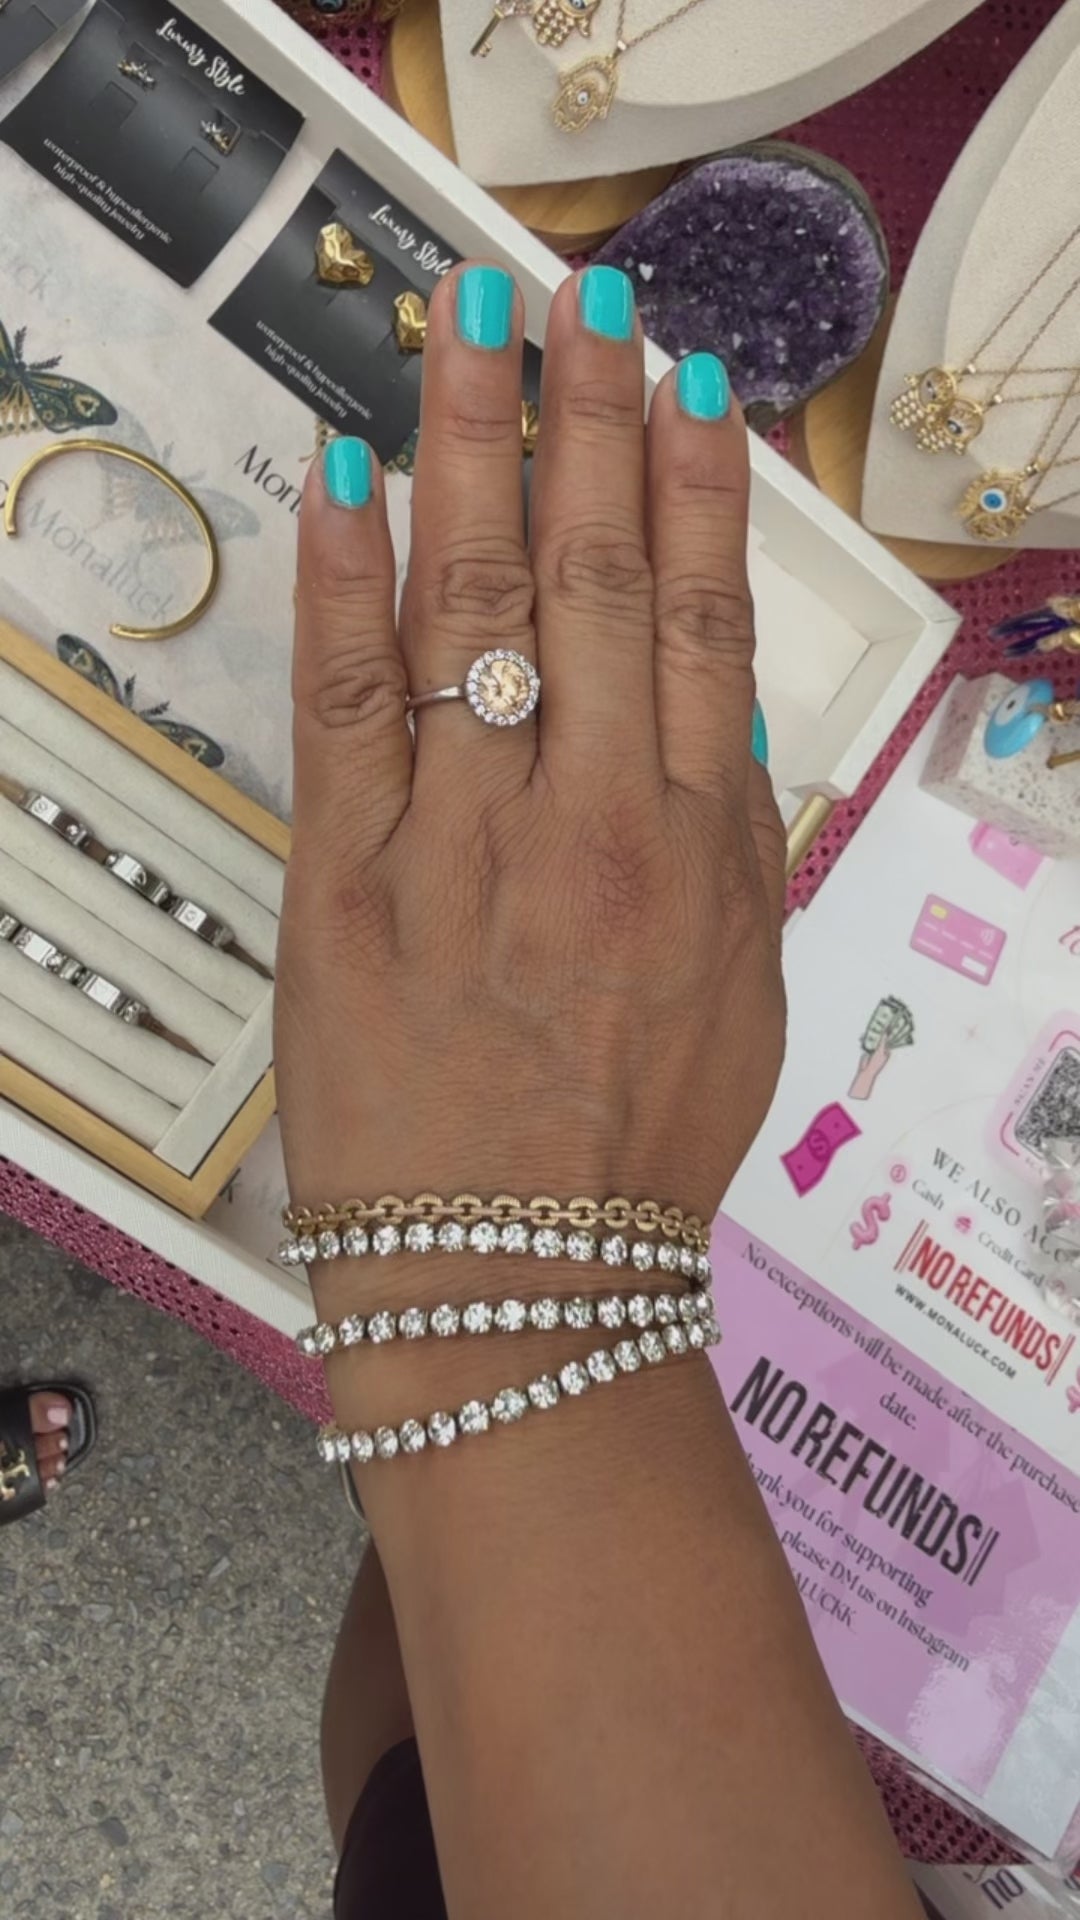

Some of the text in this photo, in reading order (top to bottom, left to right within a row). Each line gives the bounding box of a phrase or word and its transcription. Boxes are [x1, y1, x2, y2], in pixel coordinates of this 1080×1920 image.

[156, 17, 245, 95] Luxury Style
[43, 138, 99, 183] waterproof
[96, 180, 107, 191] &
[368, 204, 416, 250] Luxury
[256, 320, 306, 363] waterproof
[303, 359, 314, 370] &
[233, 444, 303, 517] Mon
[911, 1178, 945, 1211] Cash
[933, 1147, 965, 1184] WE
[965, 1179, 1021, 1226] ALSO
[977, 1231, 1046, 1288] Credit Card
[894, 1283, 1017, 1380] WWW.MONALUCK.COM
[907, 1236, 1061, 1371] NO REFUNDS
[741, 1242, 1080, 1513] No exceptions will be made after the purchase
[879, 1390, 917, 1430] date.
[730, 1356, 983, 1576] NO REFUNDS
[779, 1489, 817, 1521] you
[815, 1510, 844, 1538] for
[842, 1534, 933, 1608] supporting
[781, 1528, 971, 1672] please DM us on Instagram
